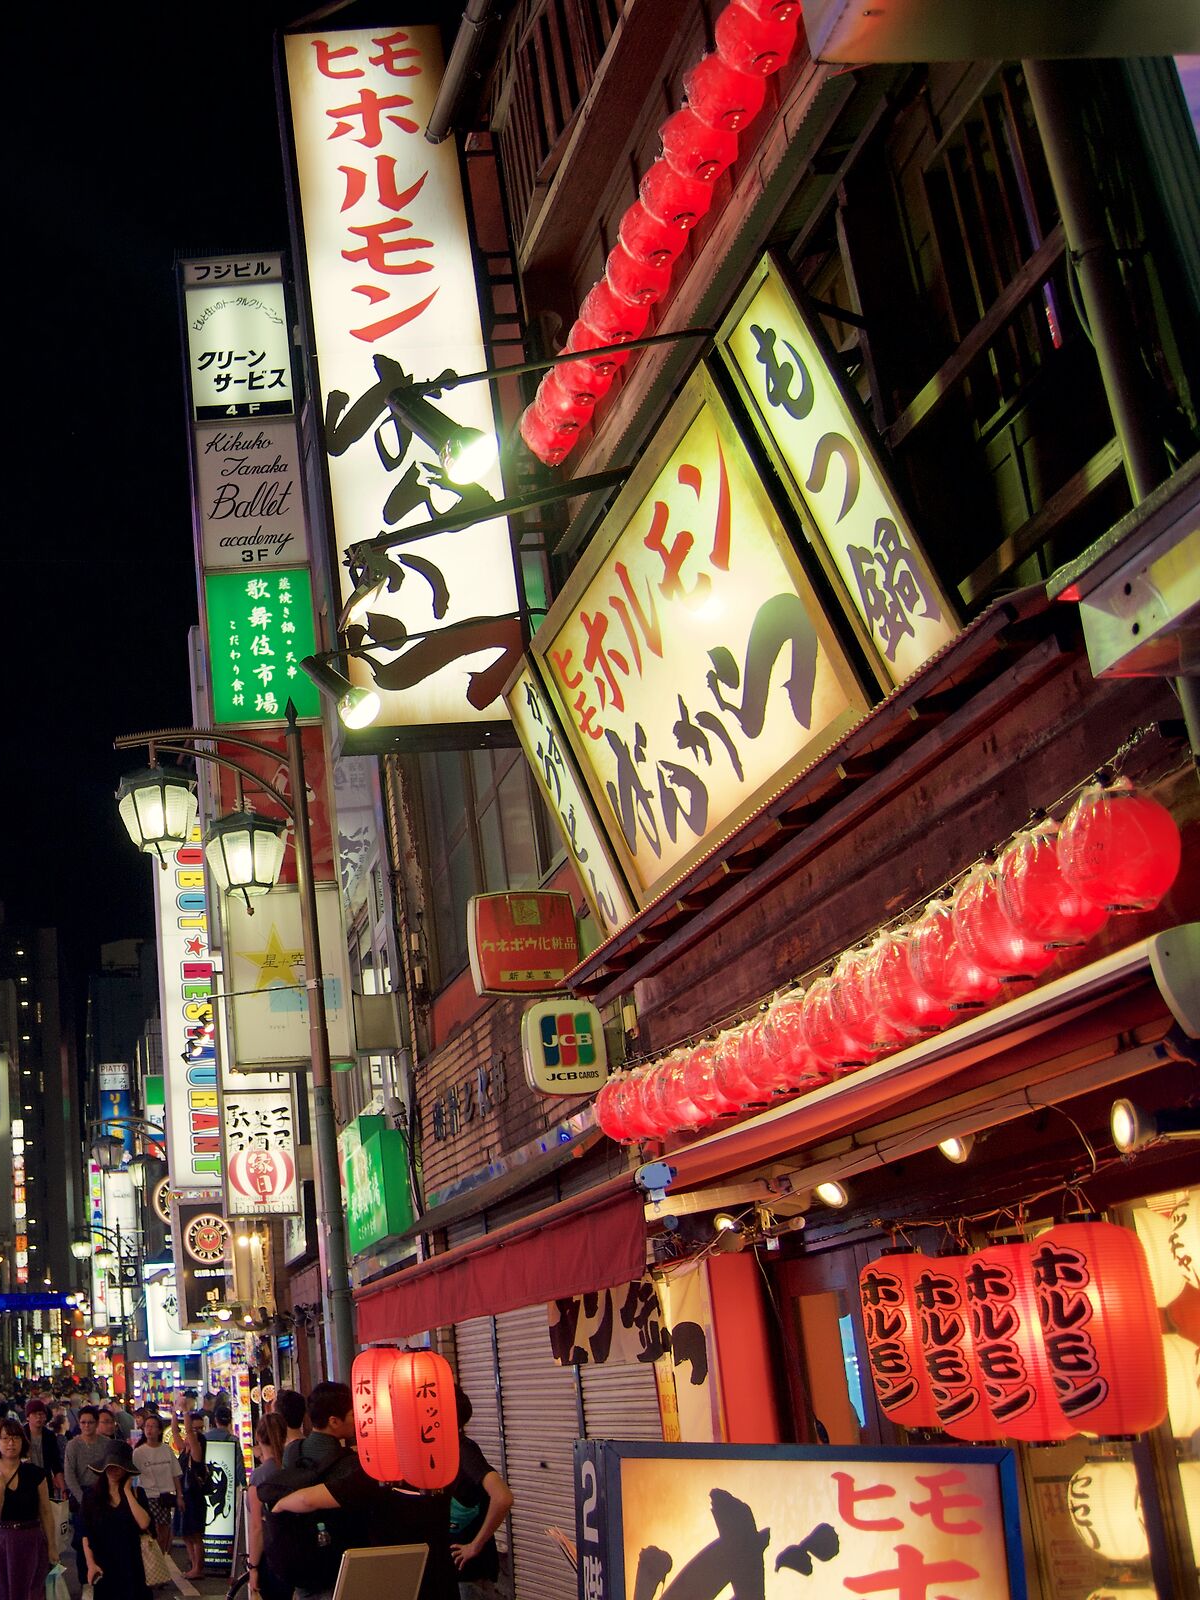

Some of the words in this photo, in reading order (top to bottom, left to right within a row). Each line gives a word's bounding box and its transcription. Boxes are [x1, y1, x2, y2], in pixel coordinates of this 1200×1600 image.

[311, 31, 423, 80] ヒモ
[326, 89, 441, 344] ホルモン
[194, 261, 272, 281] フジビル
[197, 350, 267, 370] クリーン
[213, 368, 288, 393] サービス
[204, 430, 274, 455] Kikuko
[220, 454, 289, 477] Tanaka
[207, 480, 294, 521] Ballet
[749, 323, 942, 662] もつ鍋
[218, 525, 295, 555] academy
[240, 549, 269, 563] 3F
[580, 428, 731, 713] ホルモン
[244, 577, 280, 717] 歌舞伎市場
[552, 650, 606, 742] ヒモ
[480, 936, 578, 952] カネボウ化粧品
[542, 1033, 593, 1047] JCB
[100, 1064, 128, 1073] PIATTO
[546, 1071, 578, 1082] JCB
[578, 1069, 600, 1080] CARDS
[861, 1267, 919, 1412] ホルモン
[913, 1269, 980, 1425] ホルモン
[965, 1258, 1036, 1424] ホルモン
[1031, 1240, 1108, 1420] ホルモン
[355, 1374, 374, 1463] ホッピー
[415, 1377, 441, 1470] ホッピー
[830, 1469, 984, 1535] ヒモ
